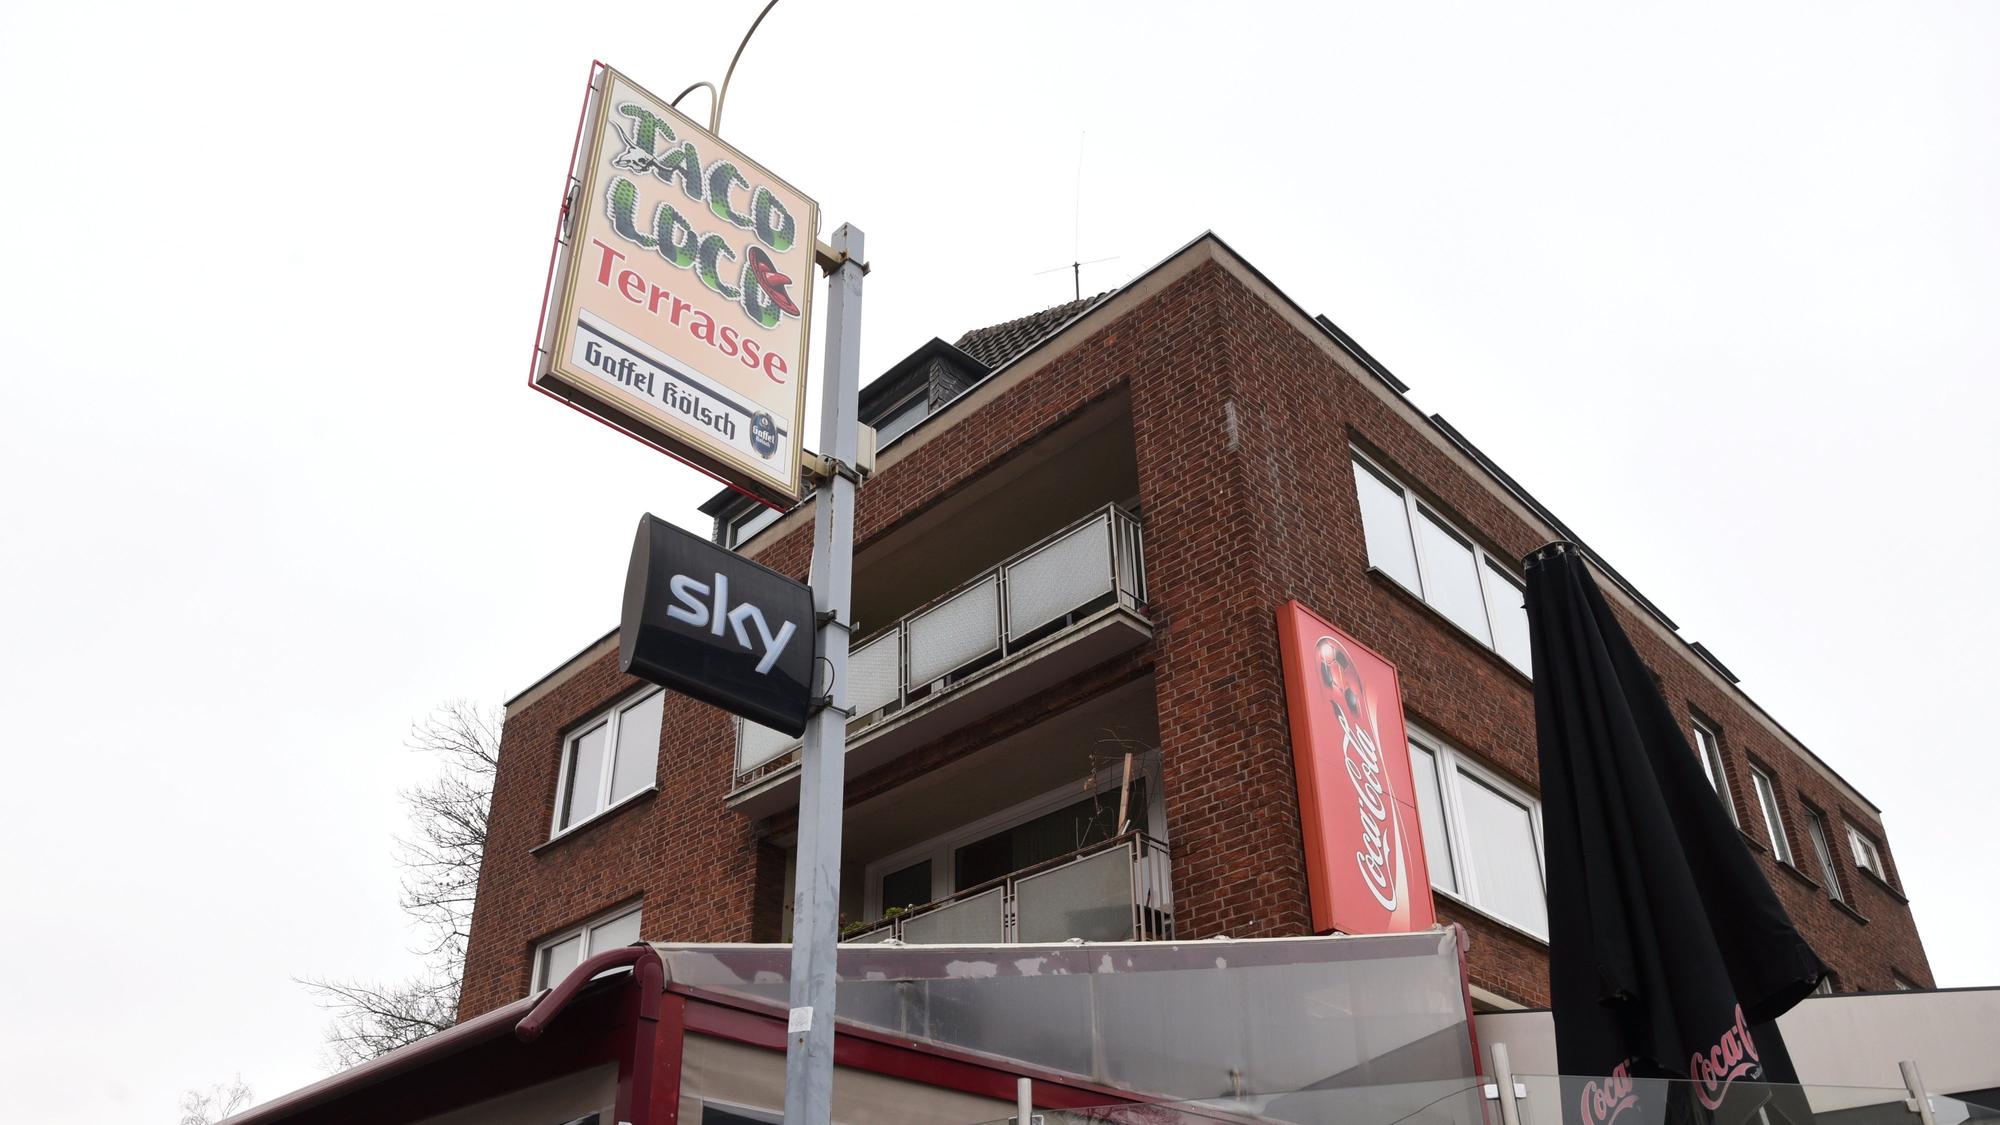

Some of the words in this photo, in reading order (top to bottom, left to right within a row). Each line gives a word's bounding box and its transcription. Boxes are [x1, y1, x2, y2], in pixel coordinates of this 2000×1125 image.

[619, 104, 795, 252] TACO
[593, 239, 788, 384] Terrasse
[607, 176, 784, 328] LOCO
[585, 341, 655, 397] Gaffel
[662, 382, 735, 440] Kölsch
[668, 572, 796, 675] sky
[1343, 703, 1397, 911] Coca-Cola
